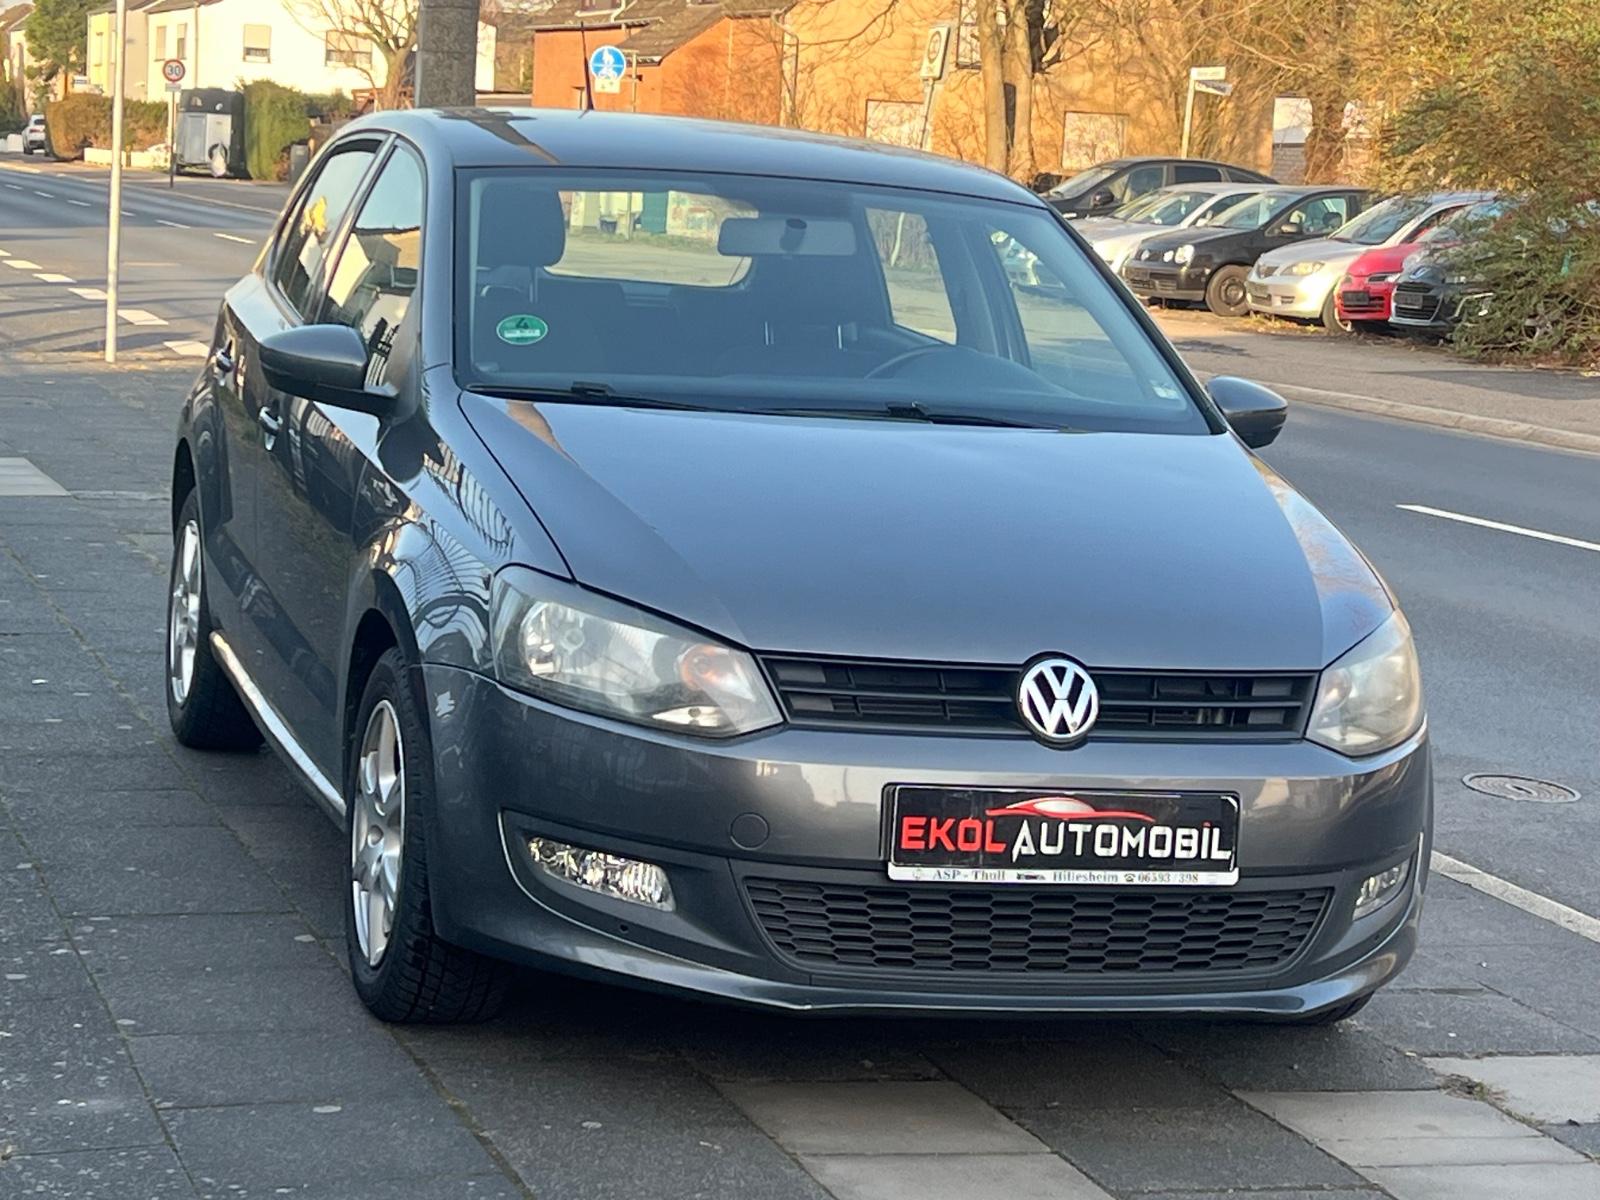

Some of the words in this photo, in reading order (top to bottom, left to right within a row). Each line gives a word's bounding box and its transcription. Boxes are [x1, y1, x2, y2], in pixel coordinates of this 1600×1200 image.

[167, 64, 181, 76] 30
[1020, 659, 1098, 738] VW
[901, 816, 1006, 853] EKOL
[932, 869, 960, 880] ASP
